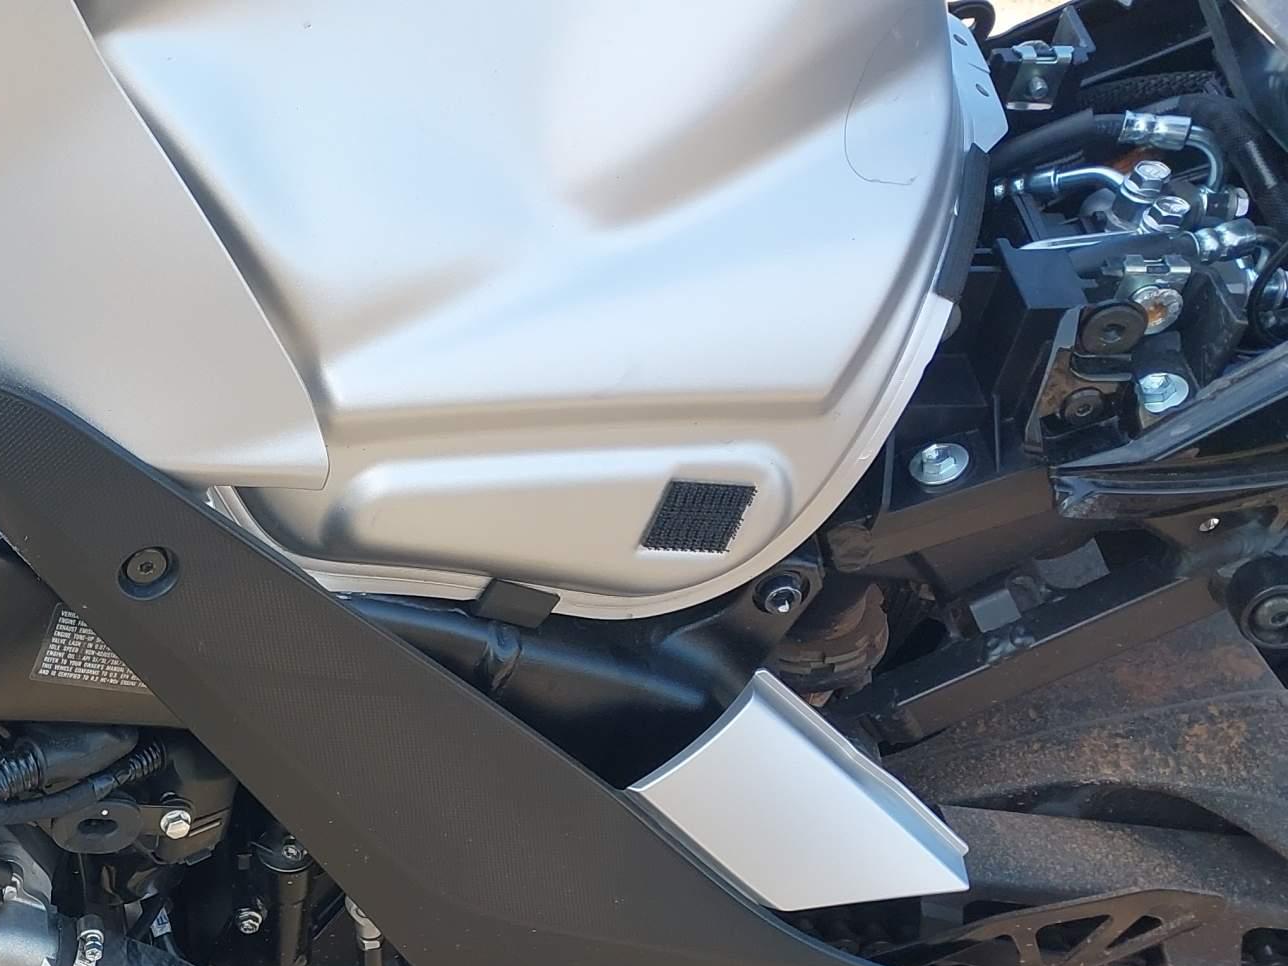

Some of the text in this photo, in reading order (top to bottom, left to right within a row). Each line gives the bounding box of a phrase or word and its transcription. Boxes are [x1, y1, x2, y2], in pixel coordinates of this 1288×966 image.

[46, 649, 65, 657] ENGINE
[63, 645, 79, 653] SPEED
[58, 671, 81, 679] CERTIFIED
